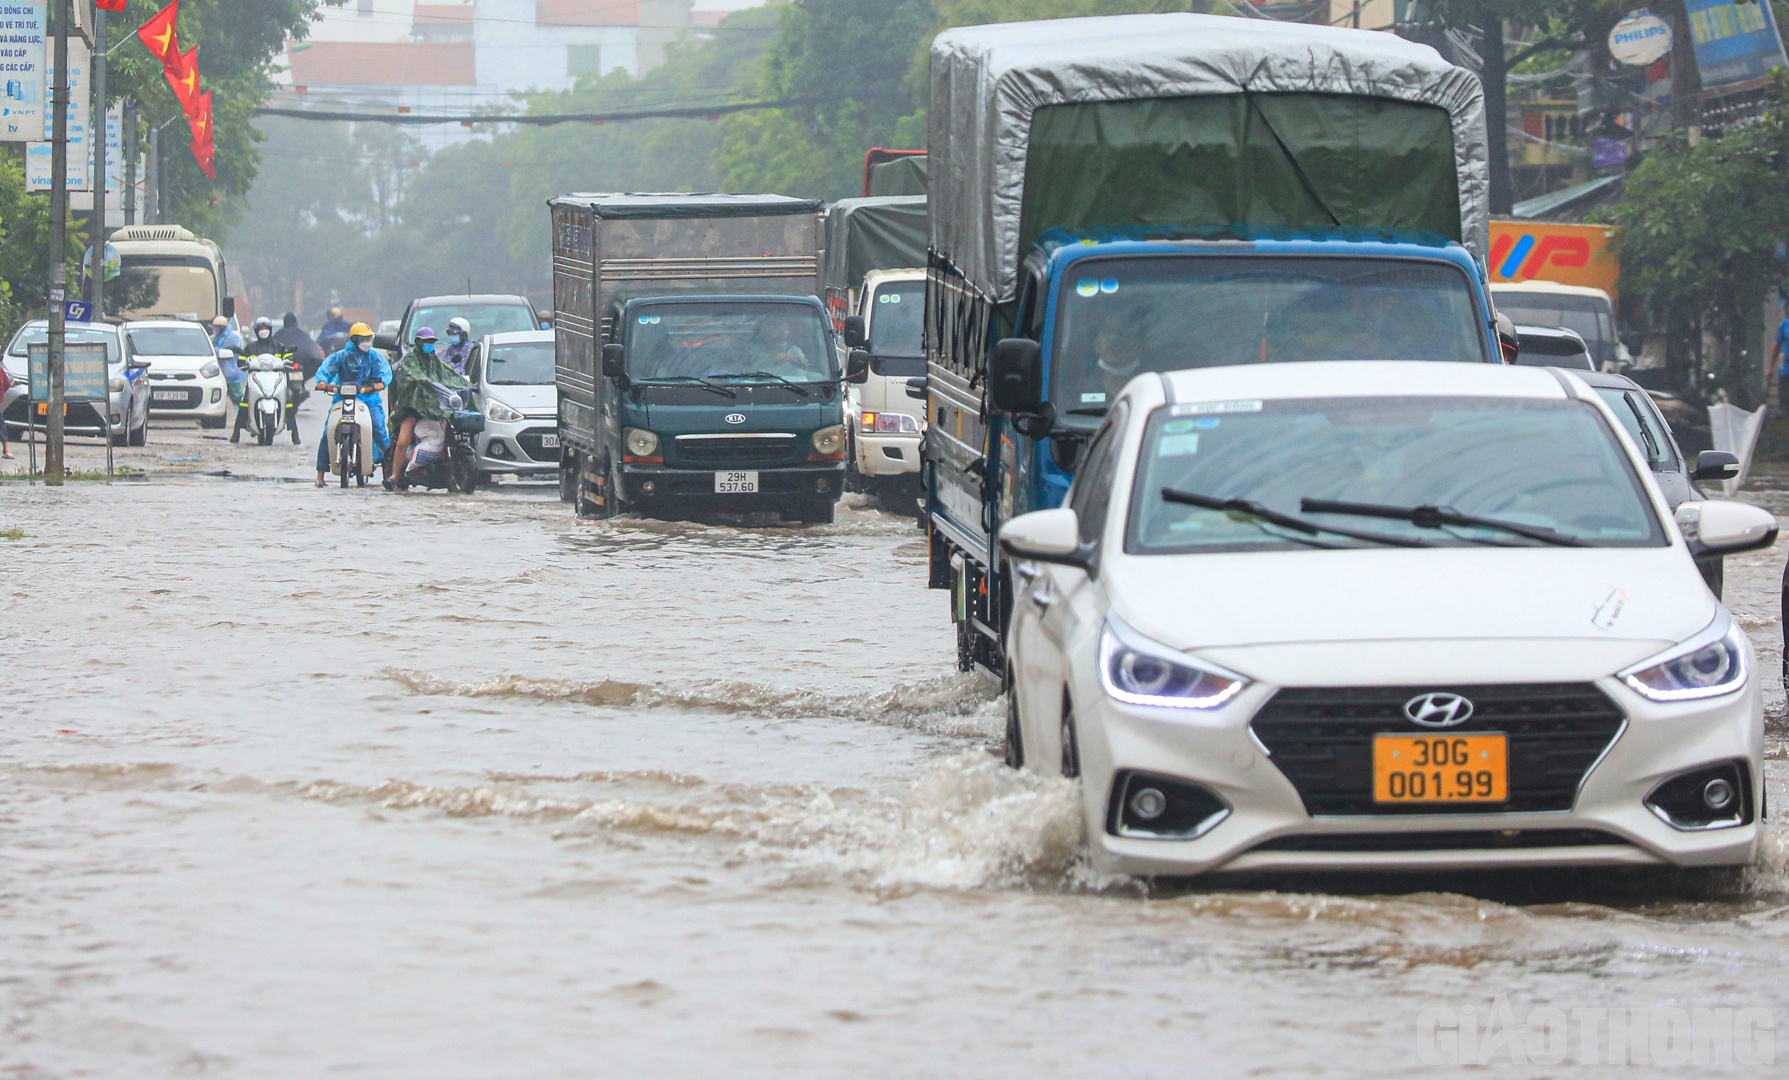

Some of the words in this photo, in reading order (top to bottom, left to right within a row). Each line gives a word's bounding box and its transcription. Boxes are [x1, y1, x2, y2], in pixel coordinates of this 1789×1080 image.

[1614, 25, 1667, 45] PHILIPS
[8, 124, 18, 132] tv
[31, 176, 84, 185] vinaone
[69, 303, 85, 319] G7
[727, 472, 747, 482] 29H
[719, 482, 754, 492] 537.60
[1412, 738, 1469, 767] 30G
[1388, 769, 1493, 798] 001.99
